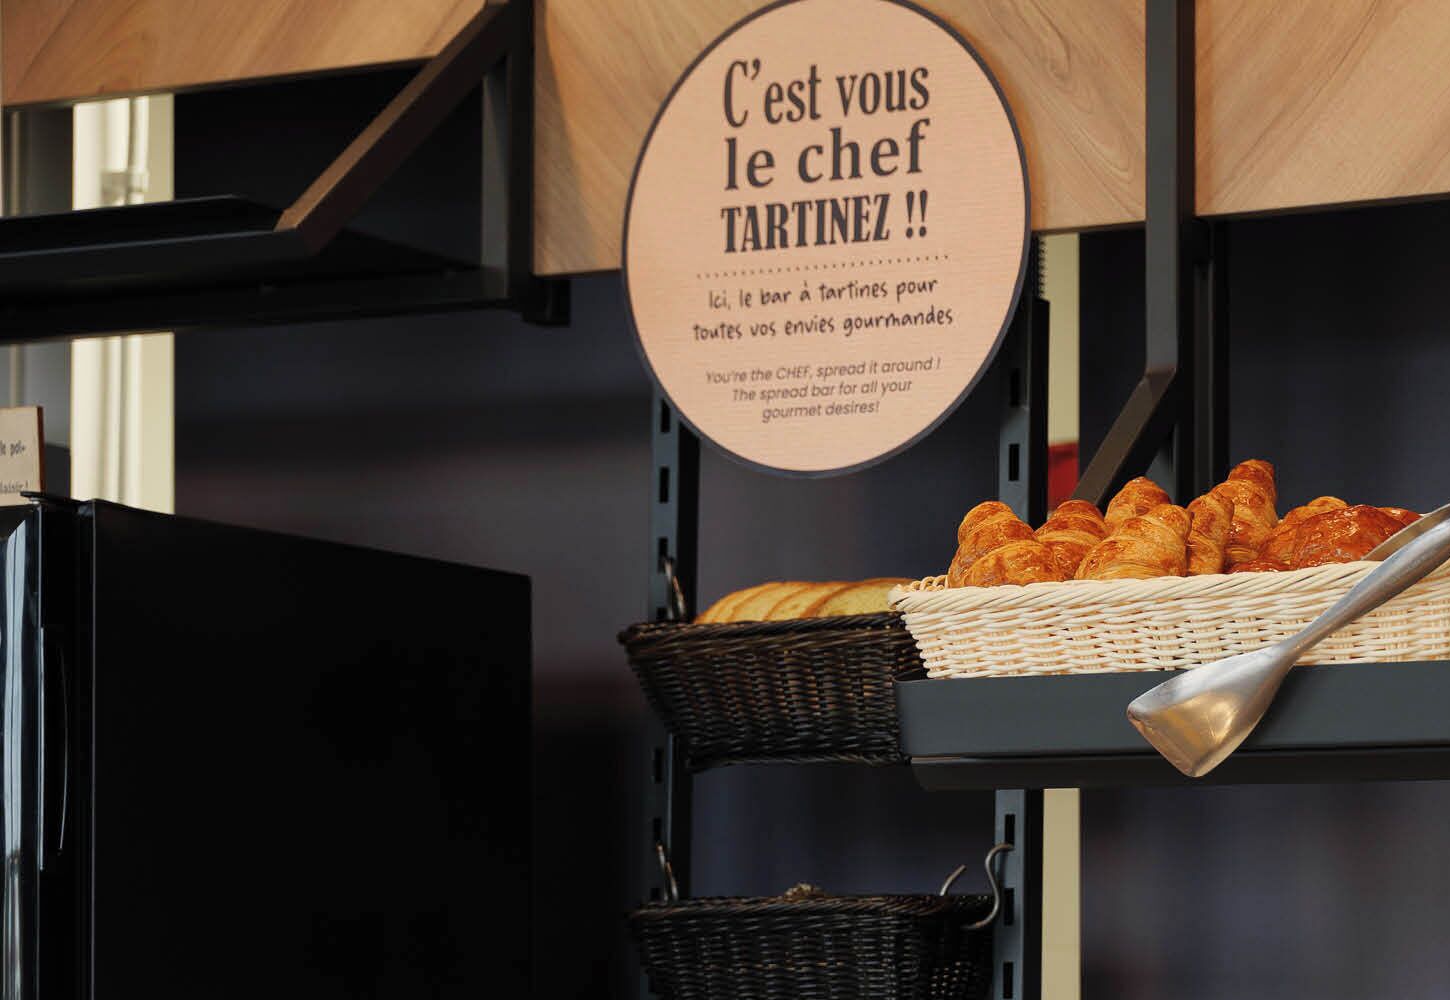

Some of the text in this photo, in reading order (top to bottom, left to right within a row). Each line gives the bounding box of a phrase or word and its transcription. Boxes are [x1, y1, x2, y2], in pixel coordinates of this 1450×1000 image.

[723, 58, 930, 128] C'est vous
[724, 118, 931, 191] le chef
[720, 190, 928, 253] TARTINEZ !!
[709, 278, 939, 311] Ici, le bar à tartines pour
[693, 305, 953, 341] toutes vos envies gourmandes
[751, 367, 773, 382] the
[776, 366, 813, 382] CHEF,
[816, 361, 866, 384] spread
[869, 360, 879, 375] it
[882, 357, 933, 374] around
[732, 379, 913, 404] The spread bar for all your
[761, 401, 880, 424] gourmet desires!
